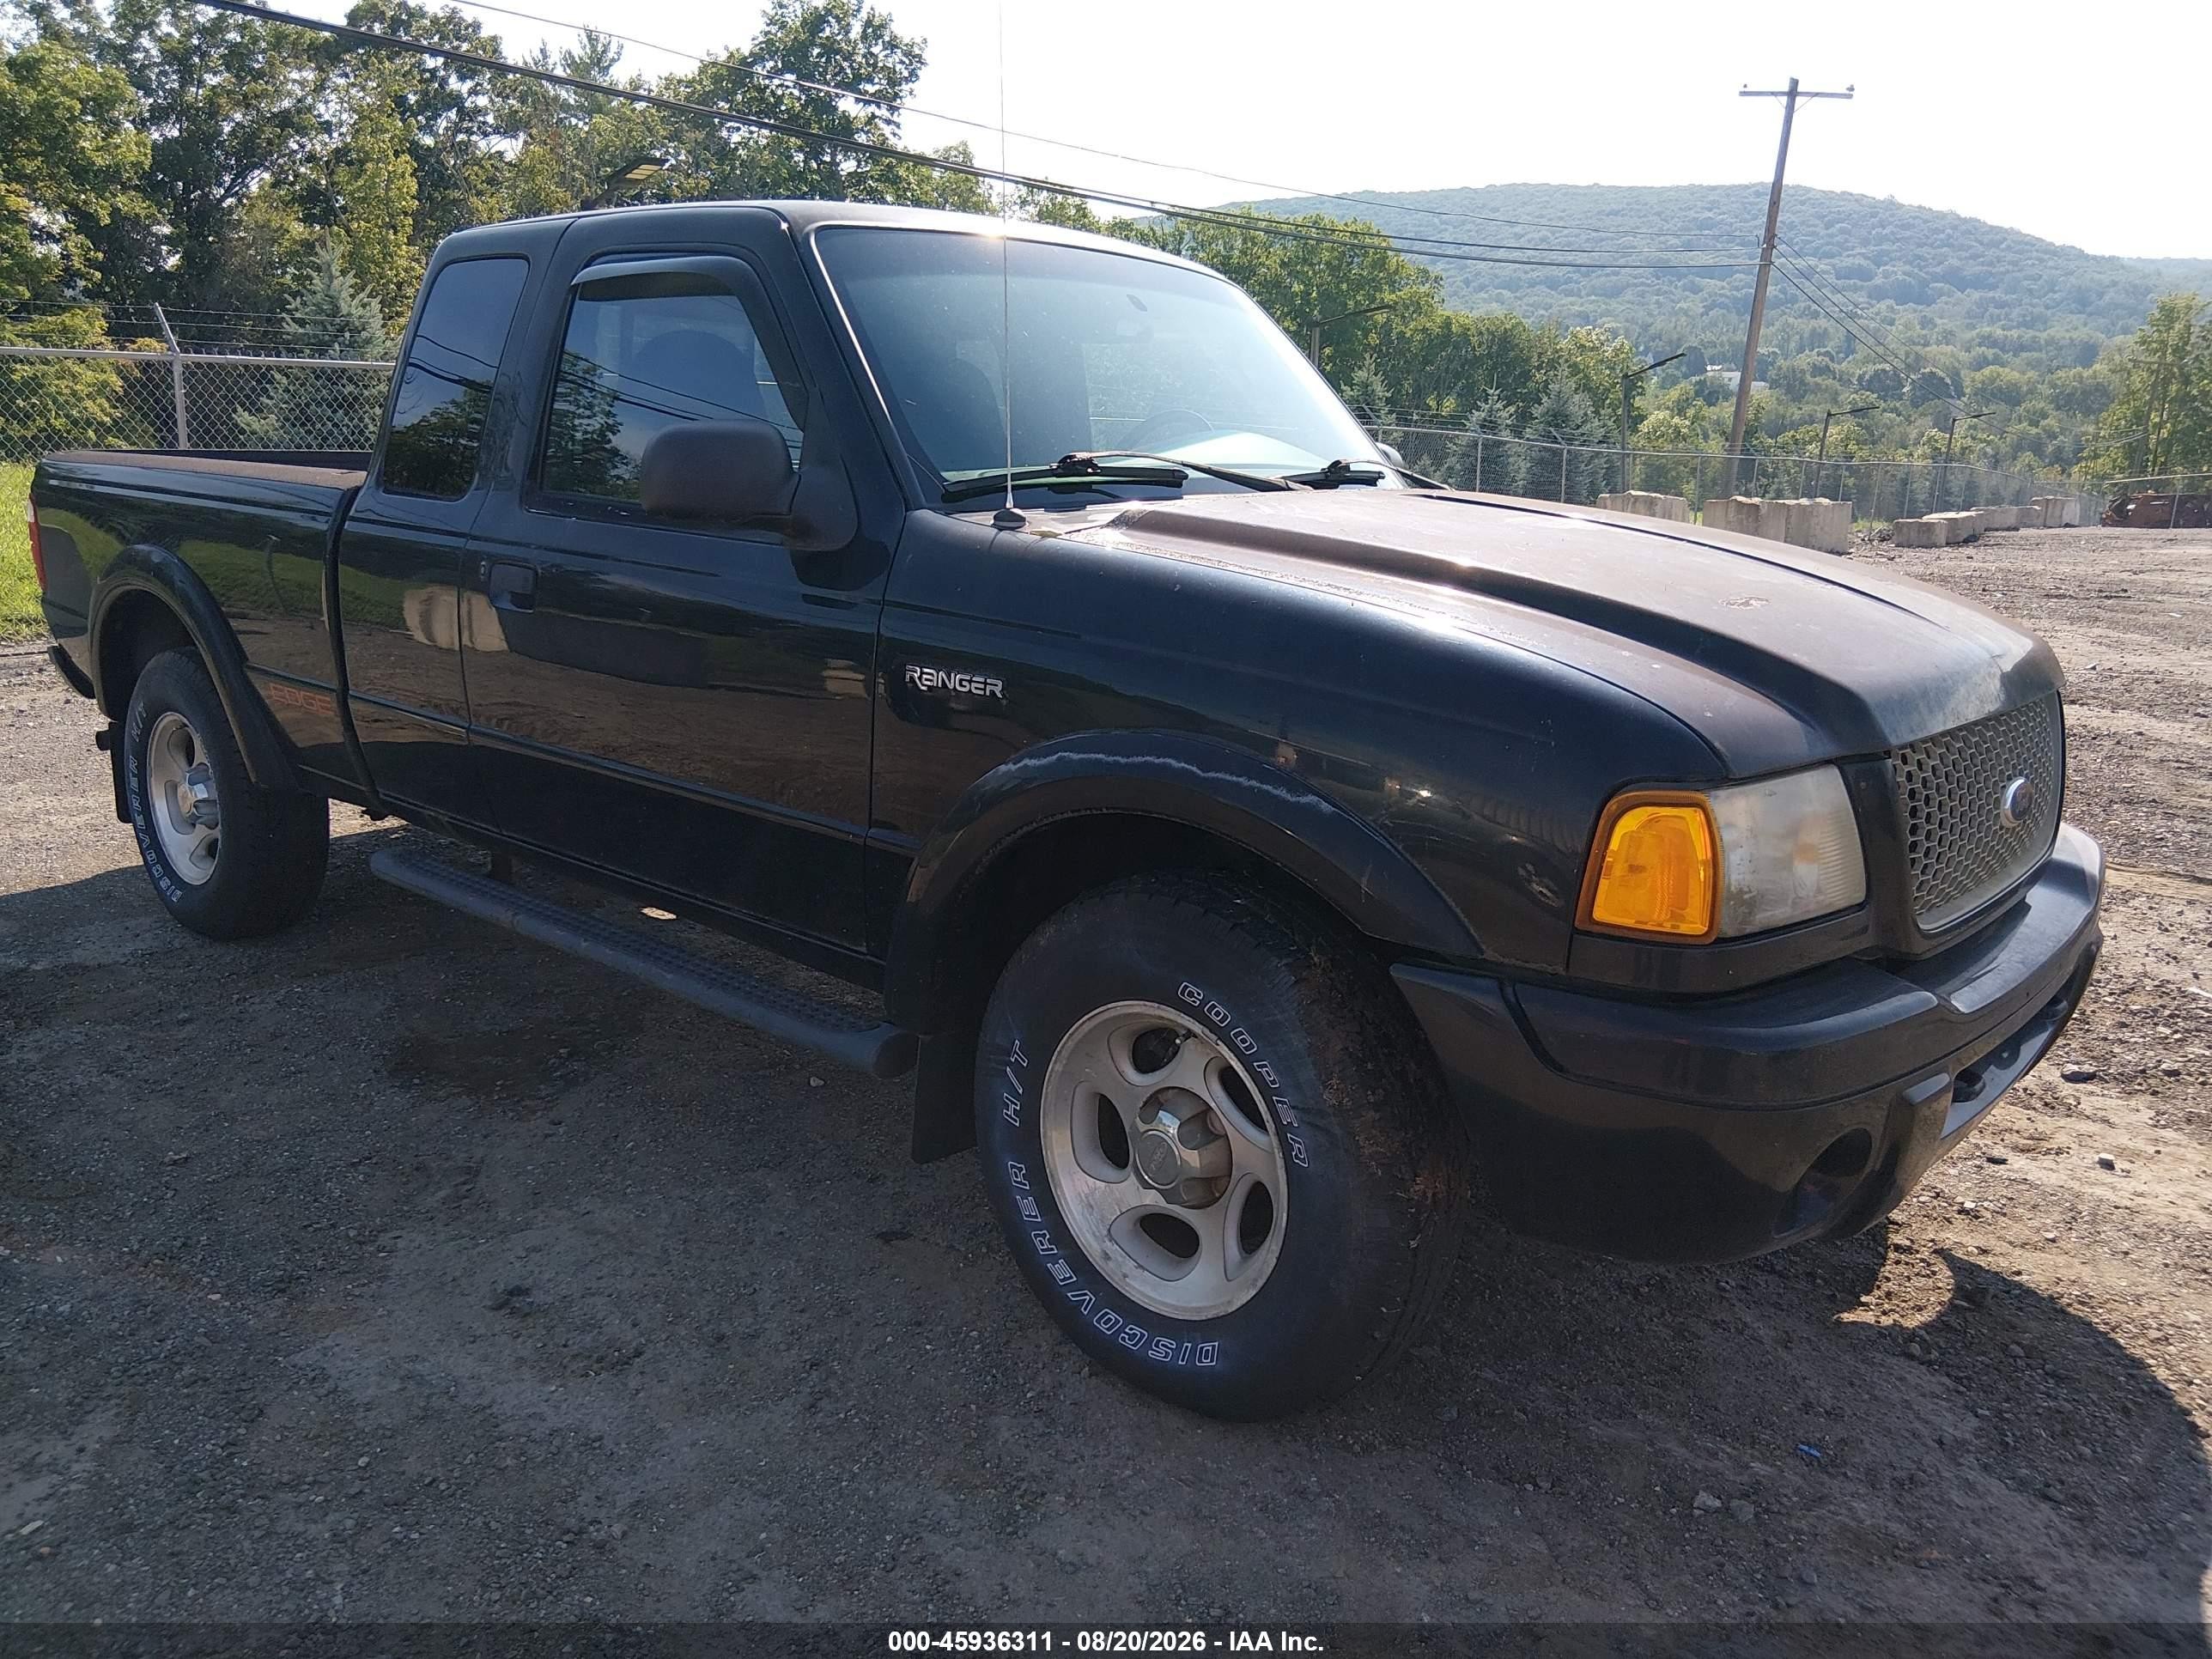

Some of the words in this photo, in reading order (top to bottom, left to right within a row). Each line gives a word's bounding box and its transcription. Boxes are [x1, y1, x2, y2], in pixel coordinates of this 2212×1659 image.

[268, 682, 336, 714] EDGE
[904, 664, 1005, 699] RANGER
[1002, 1039, 1029, 1127] H/T
[1177, 981, 1309, 1168] COOPER
[1007, 1161, 1219, 1367] DISCOVERER
